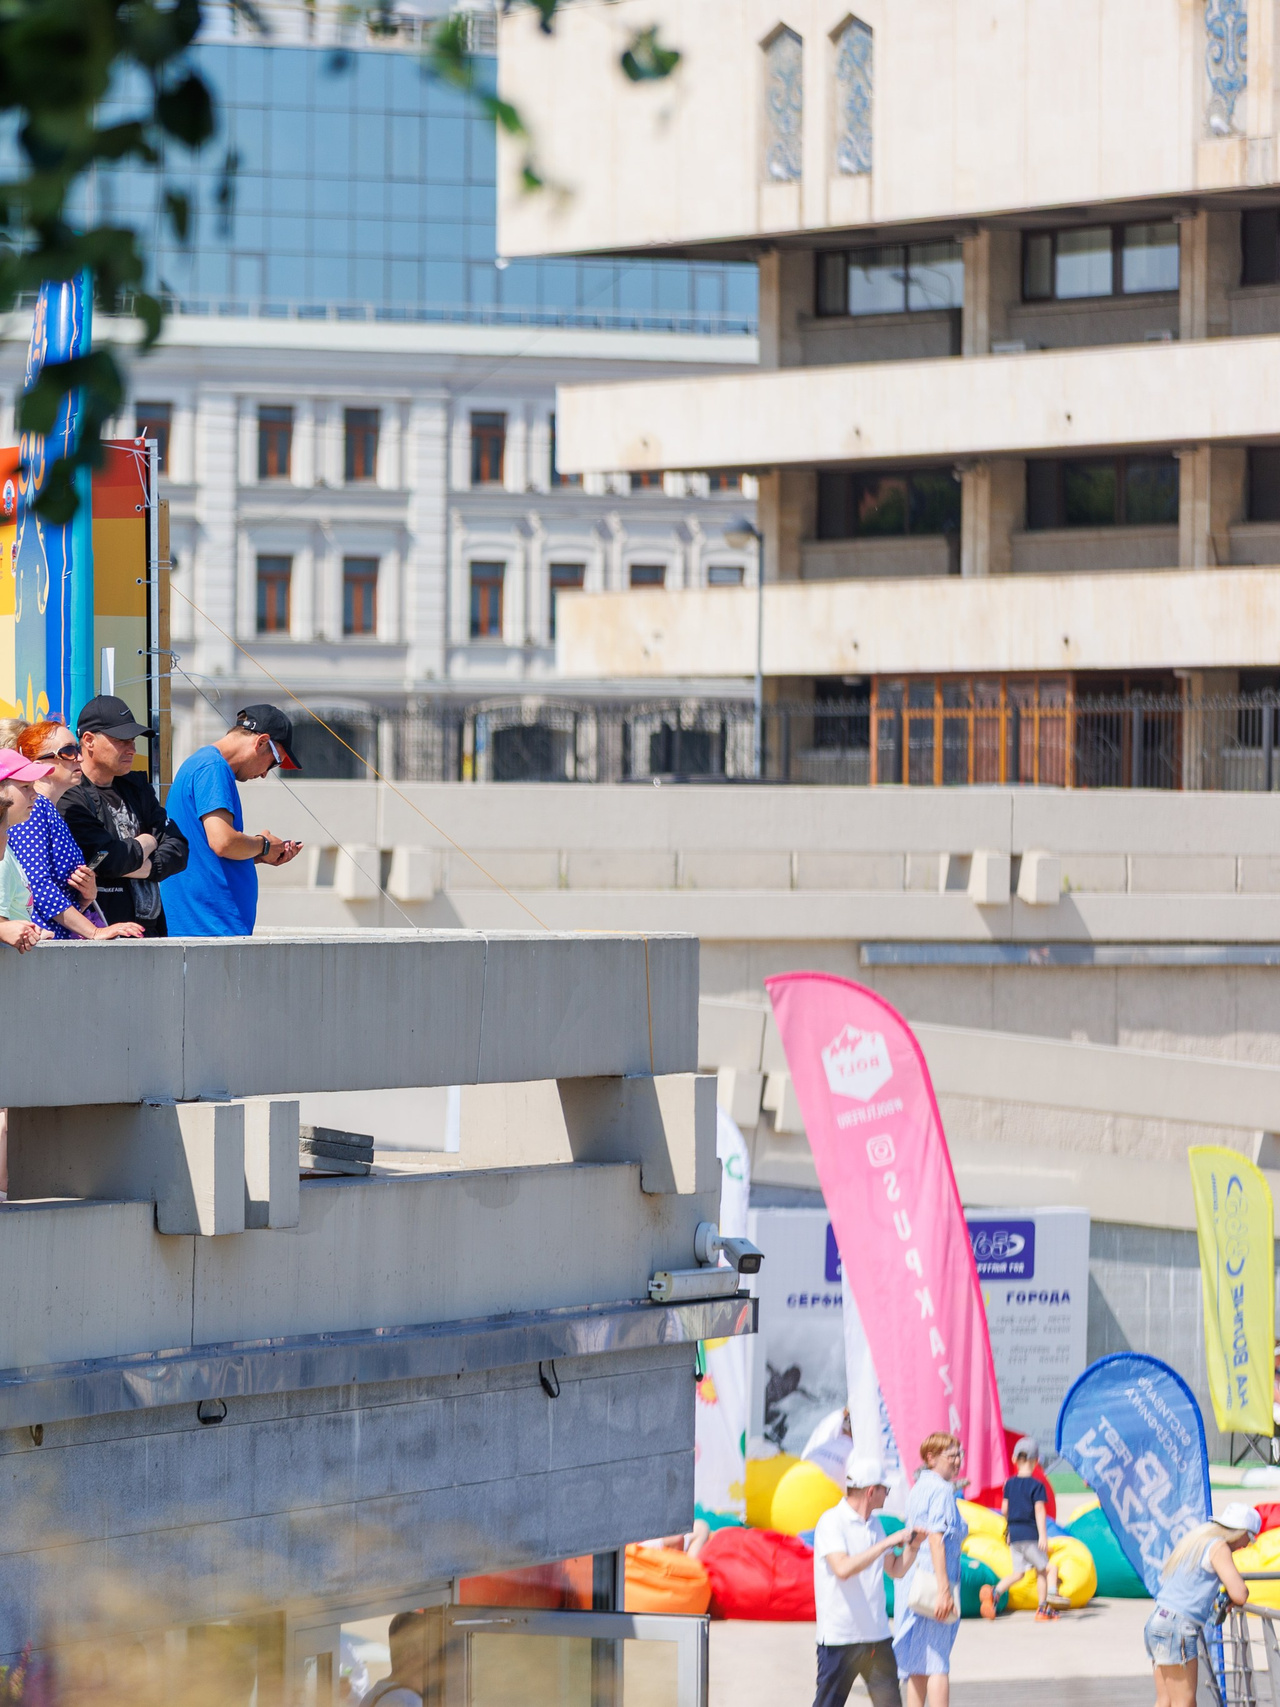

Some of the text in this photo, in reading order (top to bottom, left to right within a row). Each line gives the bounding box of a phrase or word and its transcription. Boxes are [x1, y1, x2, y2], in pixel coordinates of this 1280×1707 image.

[971, 1231, 1009, 1260] 65
[787, 1289, 1071, 1309] СЁРФИ ГОРОДА
